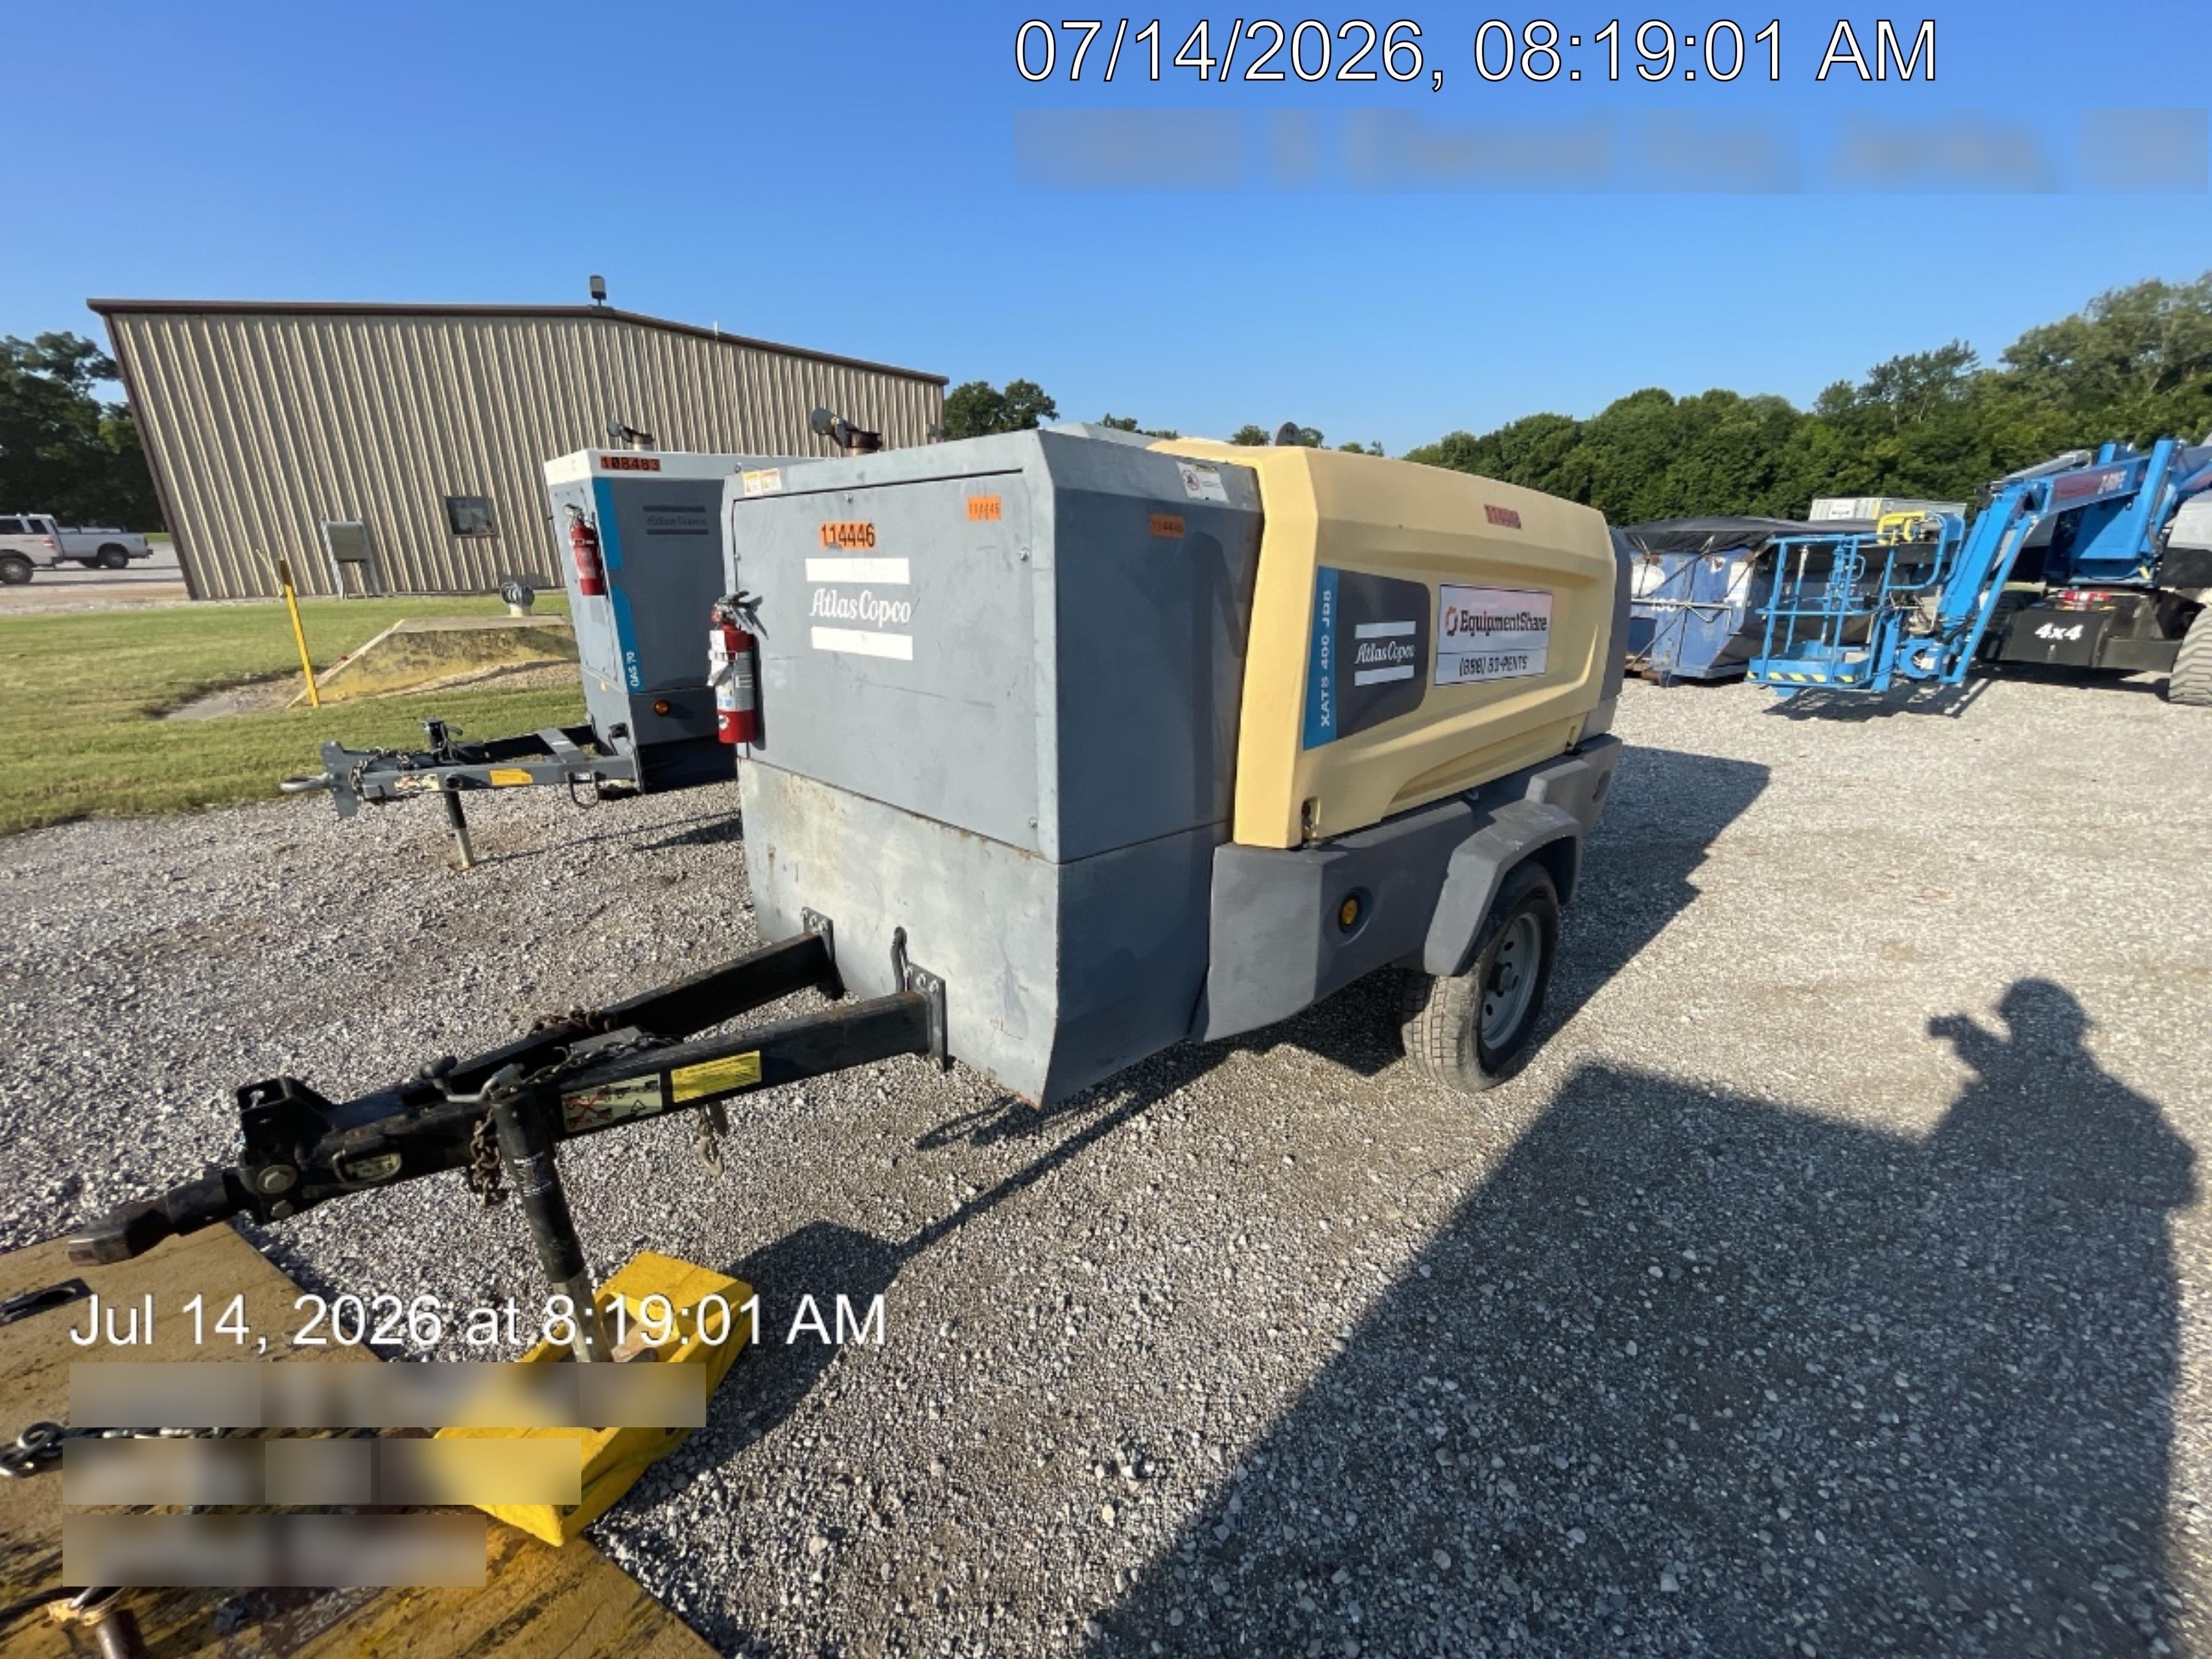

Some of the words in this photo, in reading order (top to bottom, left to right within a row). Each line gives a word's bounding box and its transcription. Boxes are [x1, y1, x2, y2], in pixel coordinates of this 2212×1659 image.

[821, 523, 876, 548] 114446
[810, 587, 858, 620] Atlas
[860, 589, 911, 628] Copco
[1459, 610, 1547, 637] EquipmentShare
[2034, 622, 2084, 640] 4x4
[1321, 635, 1330, 670] 400
[1354, 643, 1387, 664] Atlas
